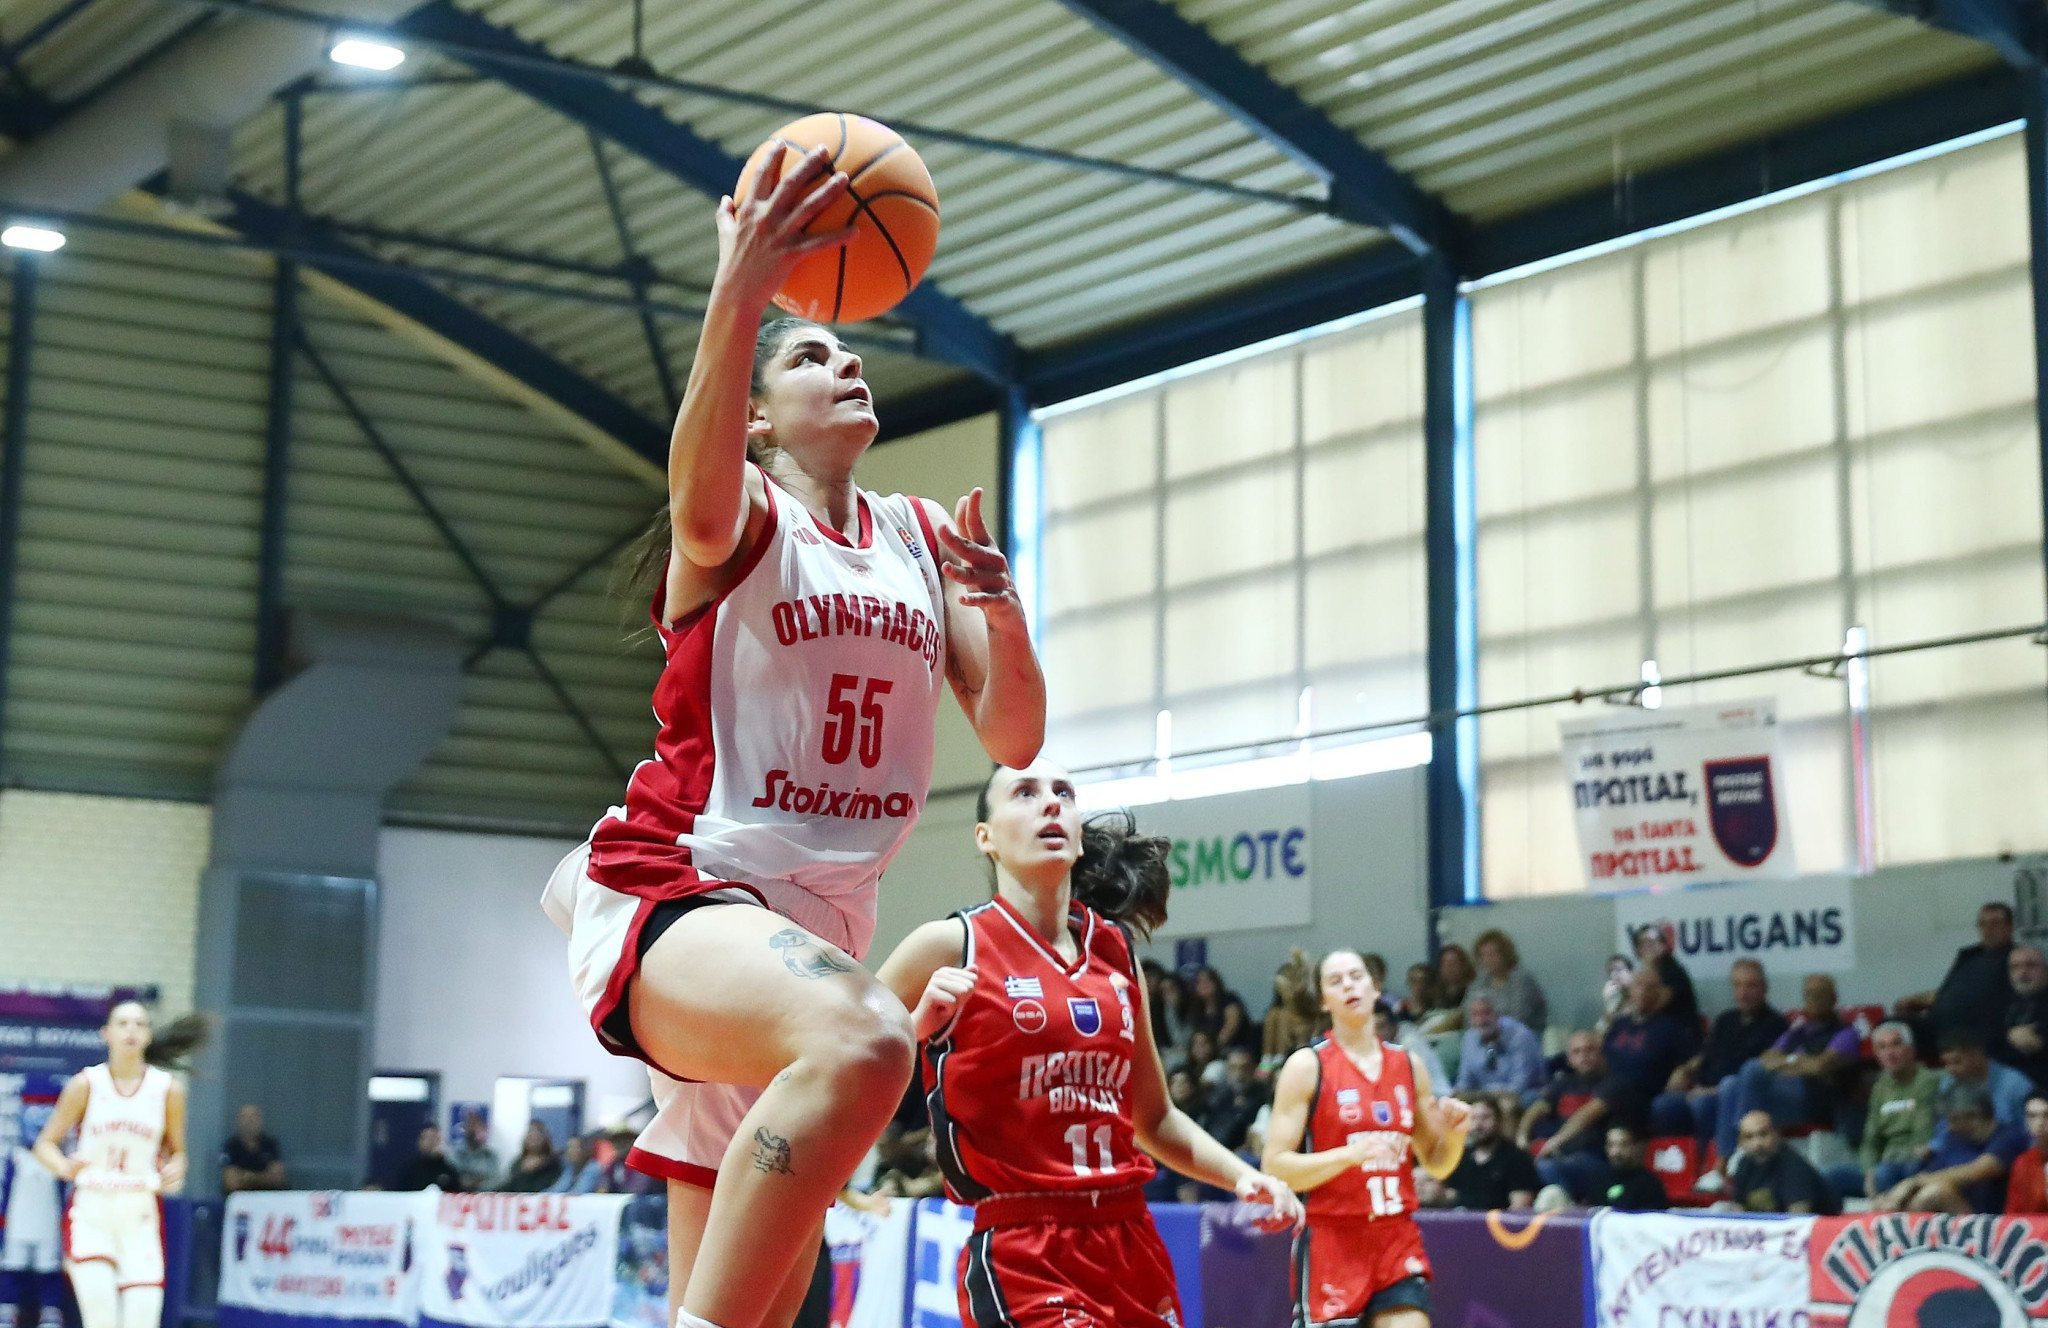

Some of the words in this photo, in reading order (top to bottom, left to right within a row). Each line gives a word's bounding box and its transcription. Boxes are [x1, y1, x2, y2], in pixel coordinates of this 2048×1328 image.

[772, 592, 942, 672] OLYMPIACOS
[821, 673, 894, 769] 55
[752, 769, 913, 820] Stoixima
[1171, 826, 1306, 888] SMOTE
[1063, 1123, 1118, 1176] 11
